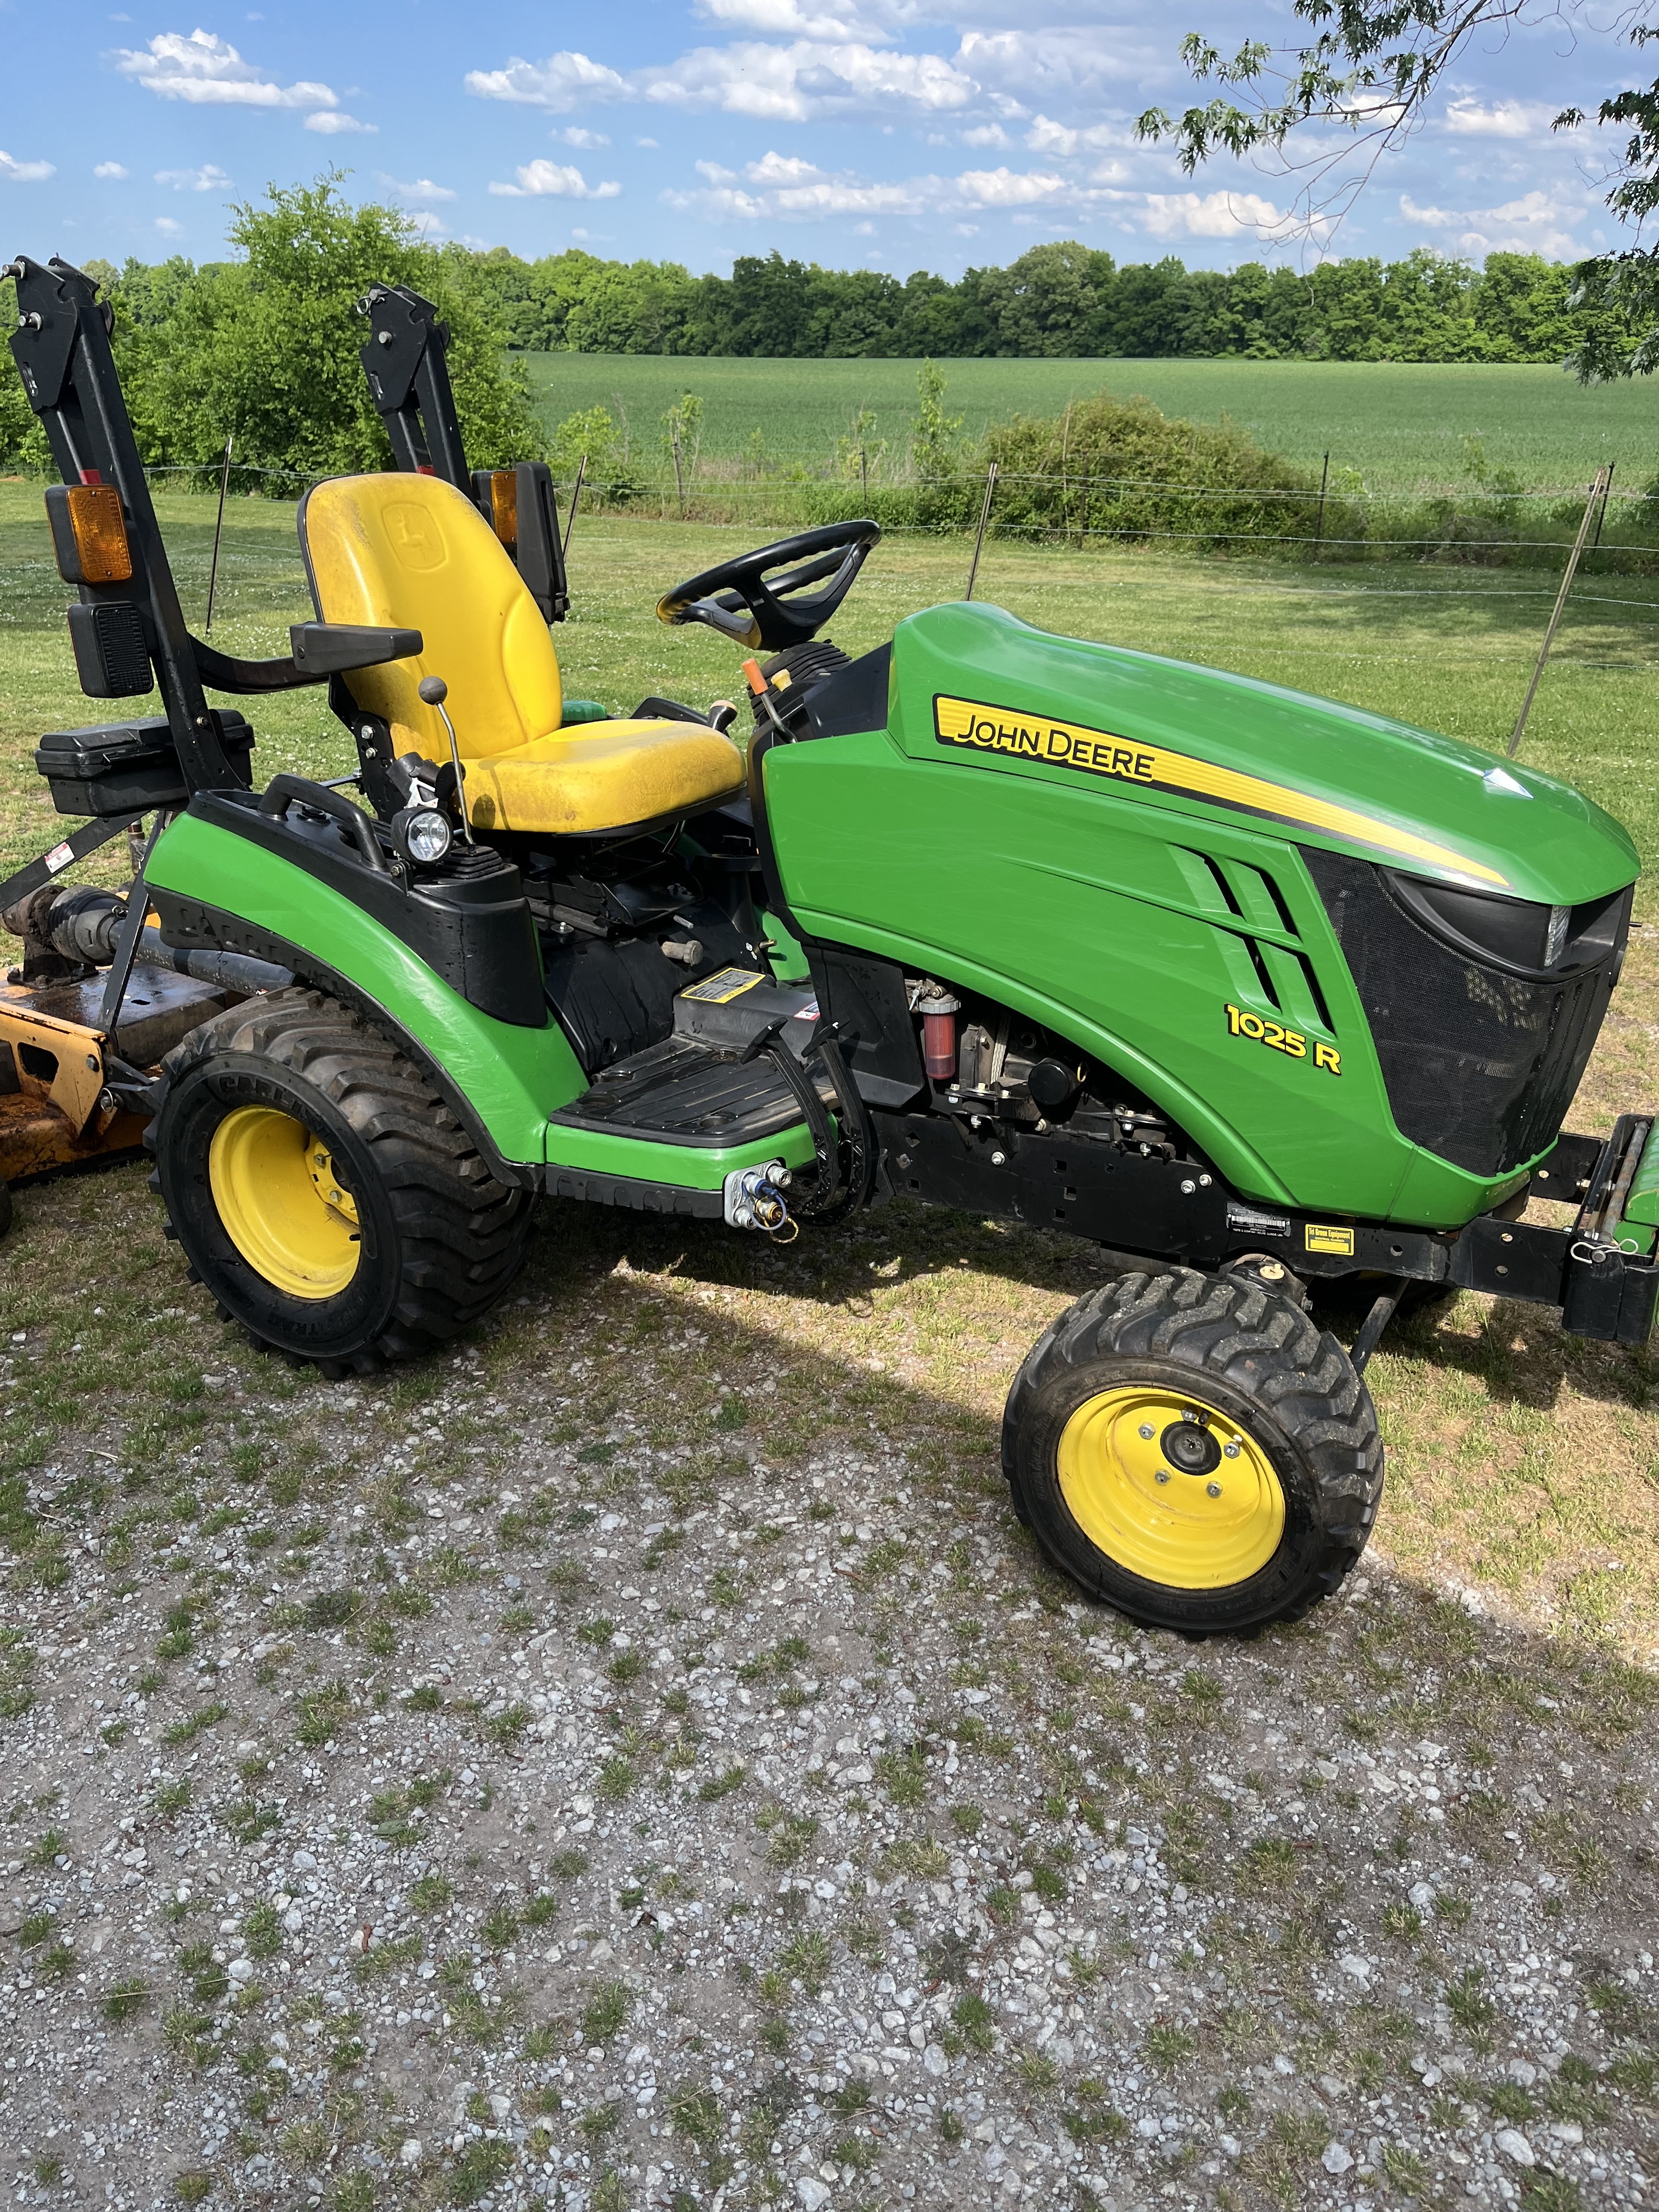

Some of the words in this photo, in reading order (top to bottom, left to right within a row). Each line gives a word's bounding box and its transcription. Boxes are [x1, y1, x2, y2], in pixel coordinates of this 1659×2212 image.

[957, 714, 1041, 753] JOHN
[1047, 729, 1156, 778] DEERE
[1224, 1003, 1307, 1058] 1025
[1313, 1041, 1342, 1076] R
[1315, 1228, 1328, 1237] Green
[1328, 1229, 1351, 1239] Equipment
